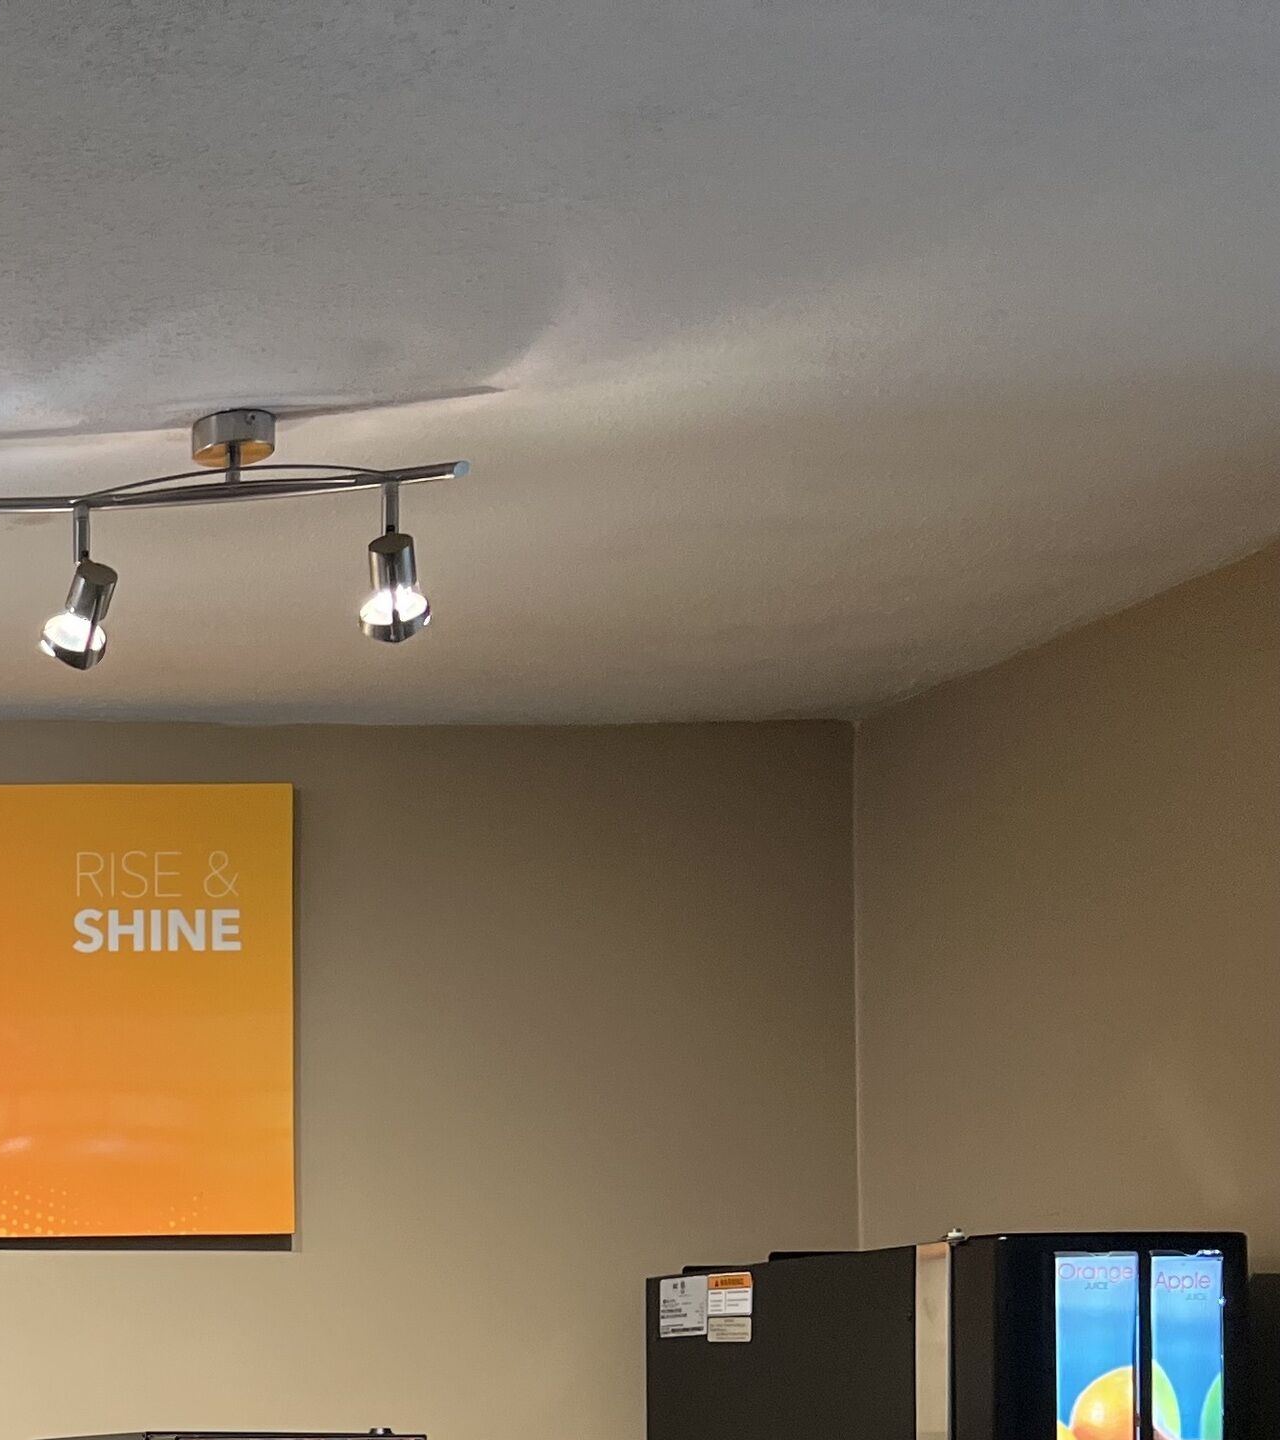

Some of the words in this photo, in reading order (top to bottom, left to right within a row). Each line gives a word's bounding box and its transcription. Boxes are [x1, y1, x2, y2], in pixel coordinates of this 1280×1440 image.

[76, 850, 183, 898] RISE
[203, 850, 239, 898] &
[72, 907, 242, 953] SHINE
[1057, 1262, 1135, 1284] Orange
[1154, 1271, 1211, 1291] Apple
[1084, 1281, 1109, 1290] JUICE
